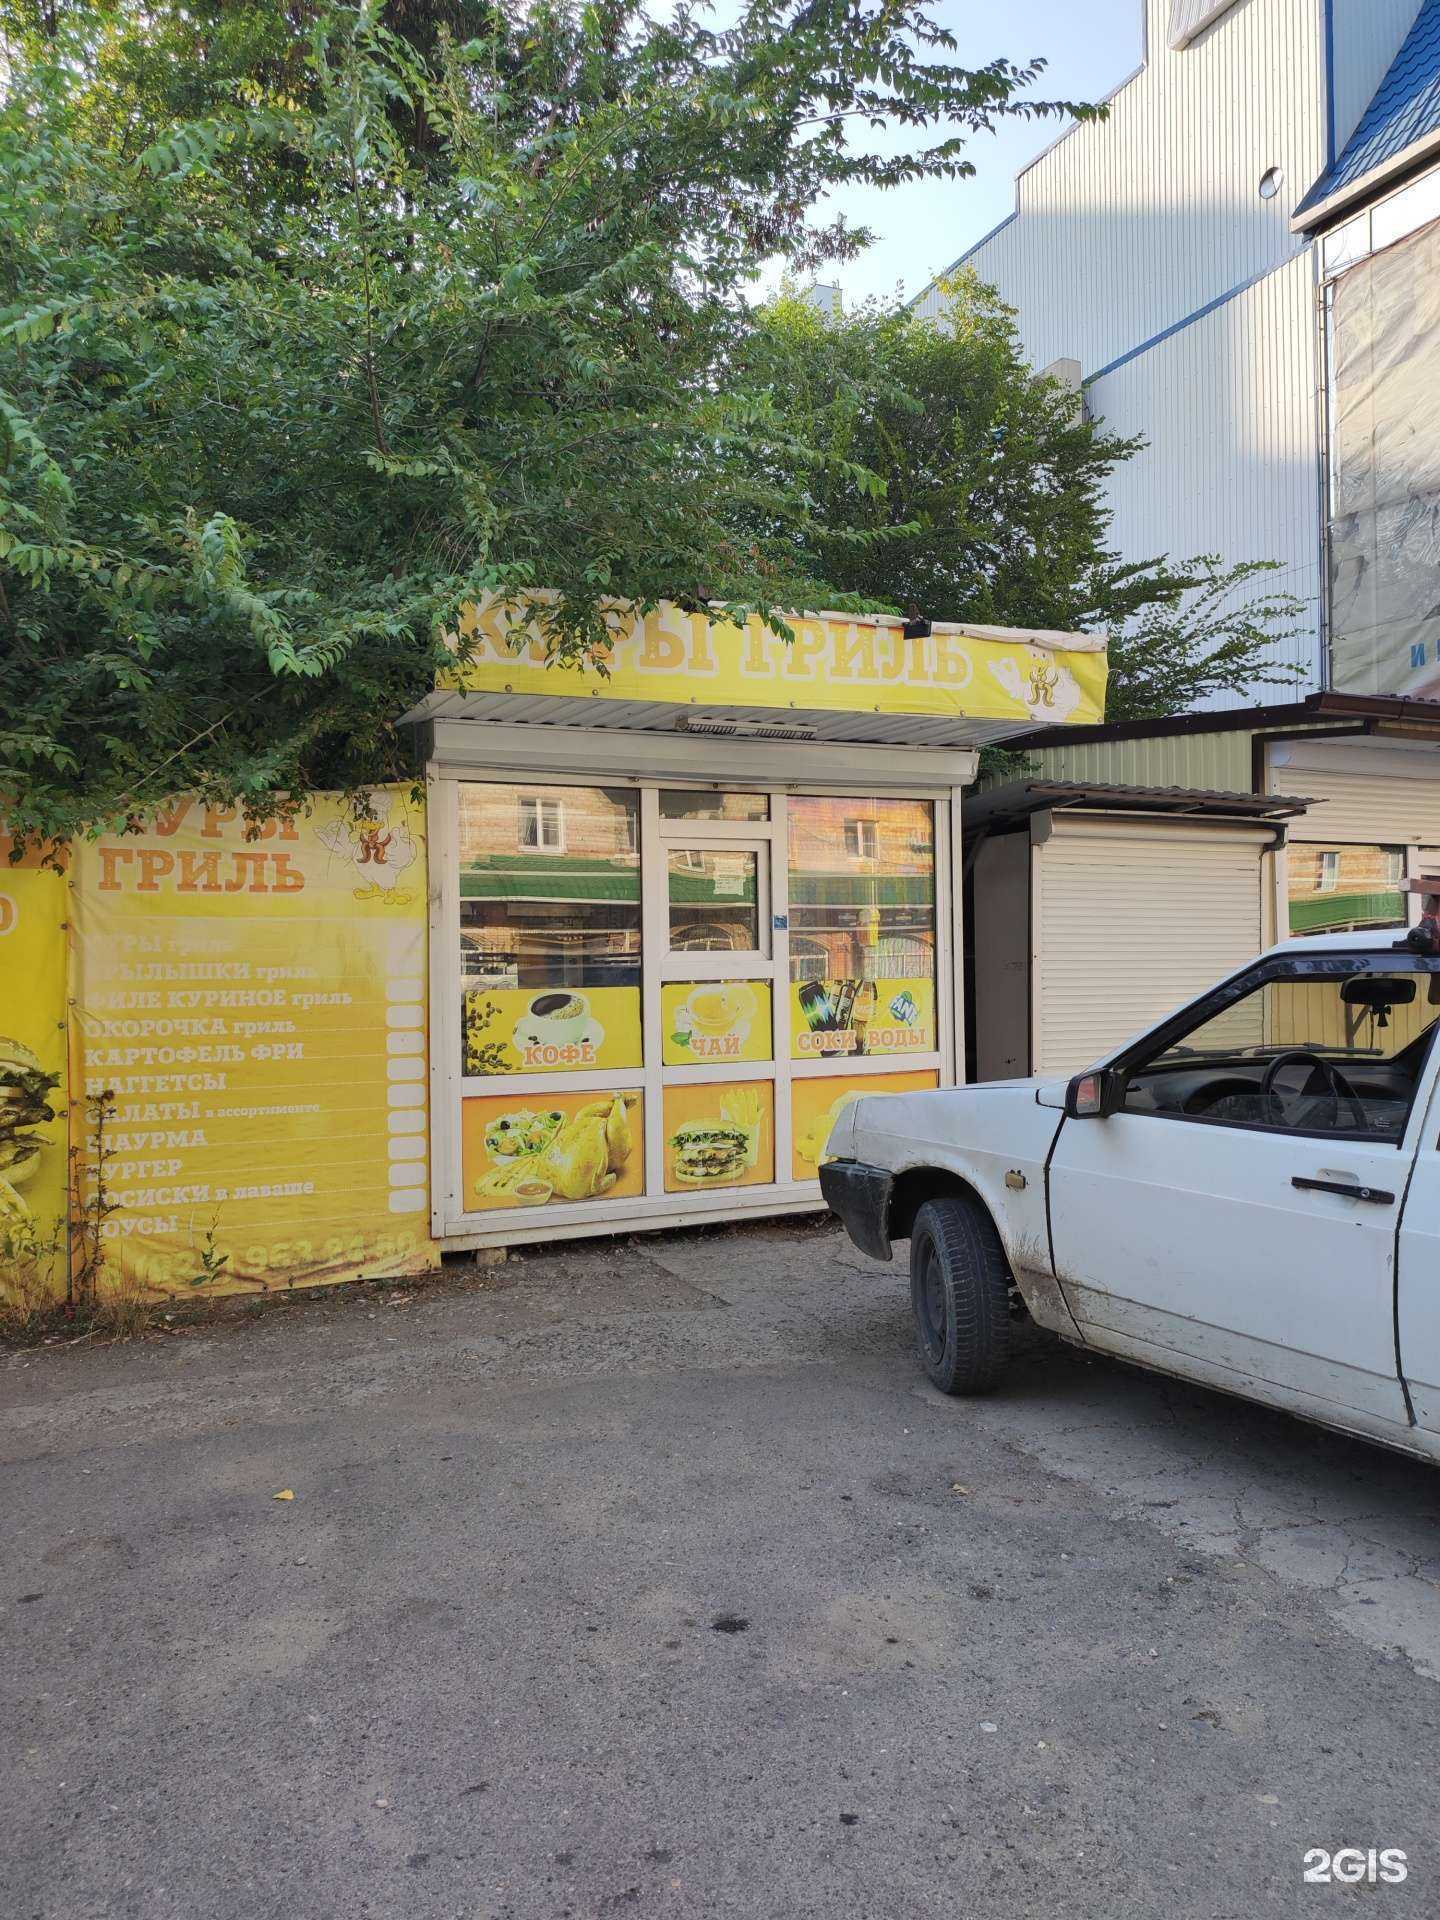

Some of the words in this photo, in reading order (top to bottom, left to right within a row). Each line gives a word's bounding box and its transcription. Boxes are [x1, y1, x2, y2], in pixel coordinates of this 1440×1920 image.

[744, 615, 968, 684] ГРИЛЬ
[102, 795, 300, 841] УРЫ
[98, 848, 305, 893] ГРИЛЬ
[92, 962, 250, 981] РЫЛЫШКИ
[167, 989, 287, 1008] КУРИНОЕ
[291, 992, 353, 1009] гриль
[84, 1017, 228, 1038] ОКОРОЧКА
[233, 1020, 296, 1037] гриль
[692, 1032, 740, 1056] ЧАЙ
[798, 1031, 856, 1051] СОКИ
[867, 1028, 927, 1048] ВОДЫ
[84, 1046, 246, 1067] КАРТОФЕЛЬ
[251, 1043, 305, 1060] ФРИ
[523, 1043, 595, 1065] КОФЕ
[85, 1073, 226, 1096] НАГГЕТСЫ
